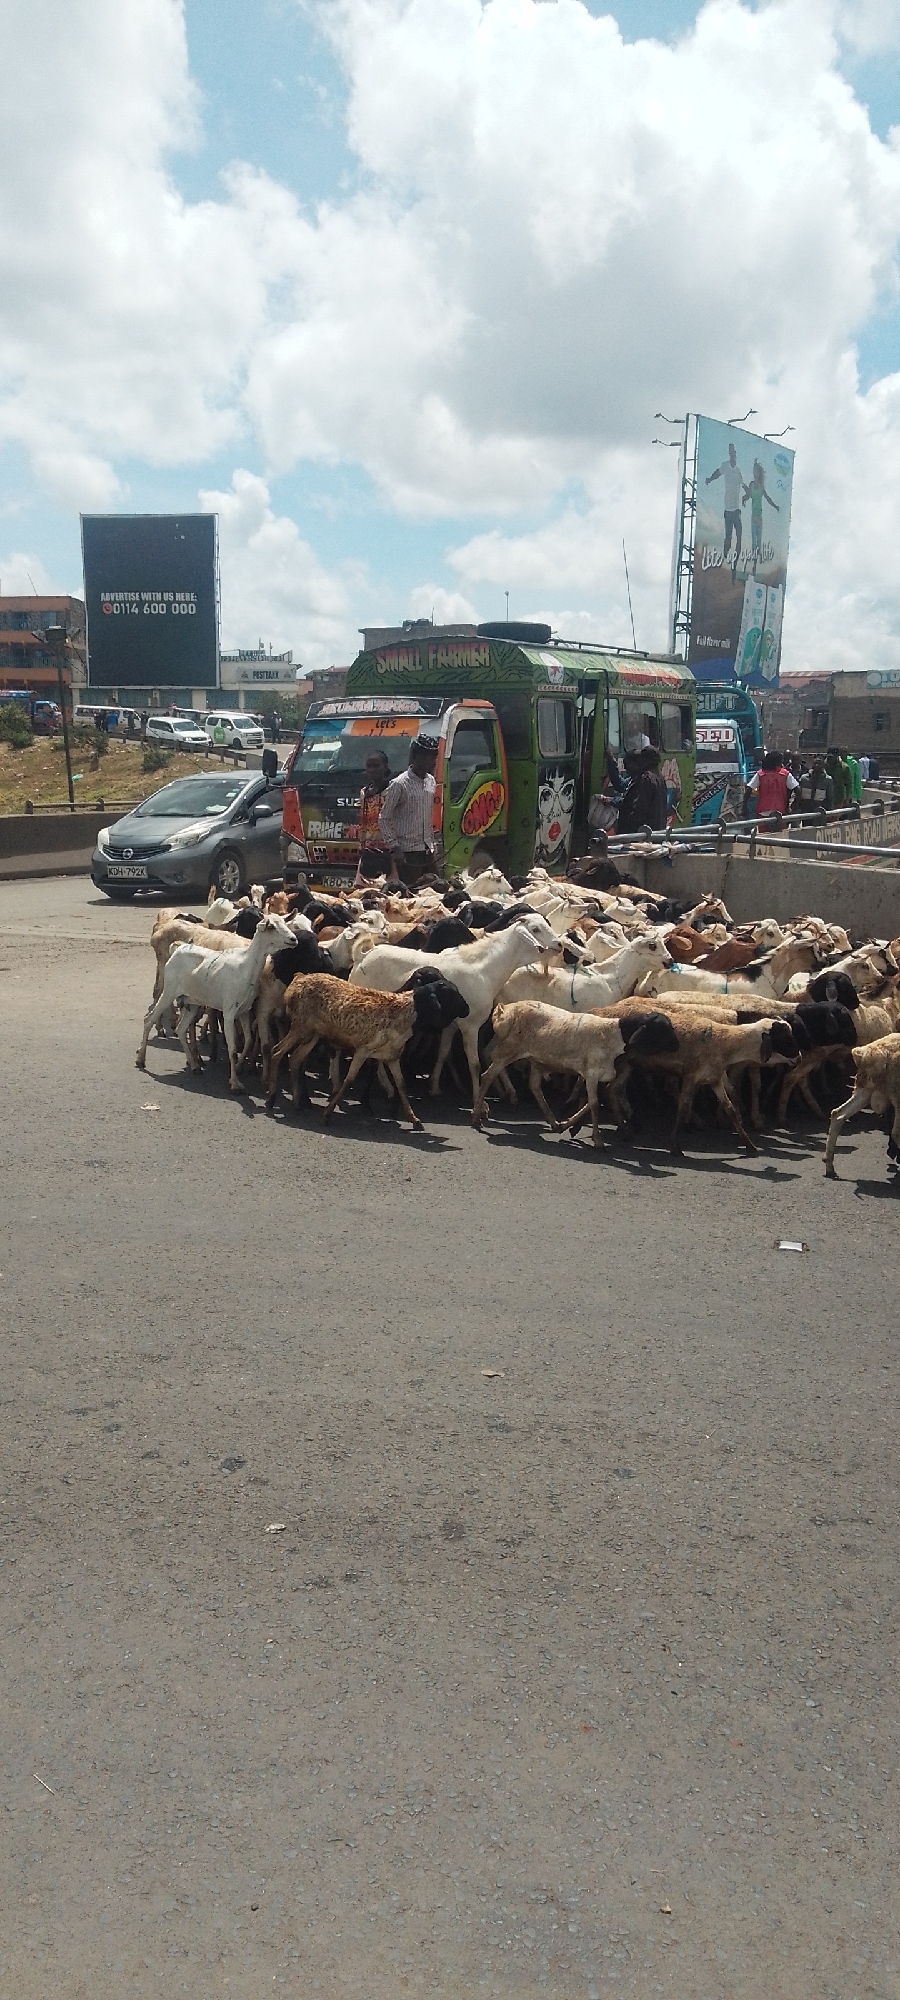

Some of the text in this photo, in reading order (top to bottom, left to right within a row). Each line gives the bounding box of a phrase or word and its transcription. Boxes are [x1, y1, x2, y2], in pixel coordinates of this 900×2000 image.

[727, 550, 738, 570] up
[100, 592, 197, 602] ADVERTISE WITH US HERE:
[113, 603, 196, 615] 0114 600 000
[376, 642, 490, 674] SMALL FARMER
[308, 820, 343, 839] PRIME
